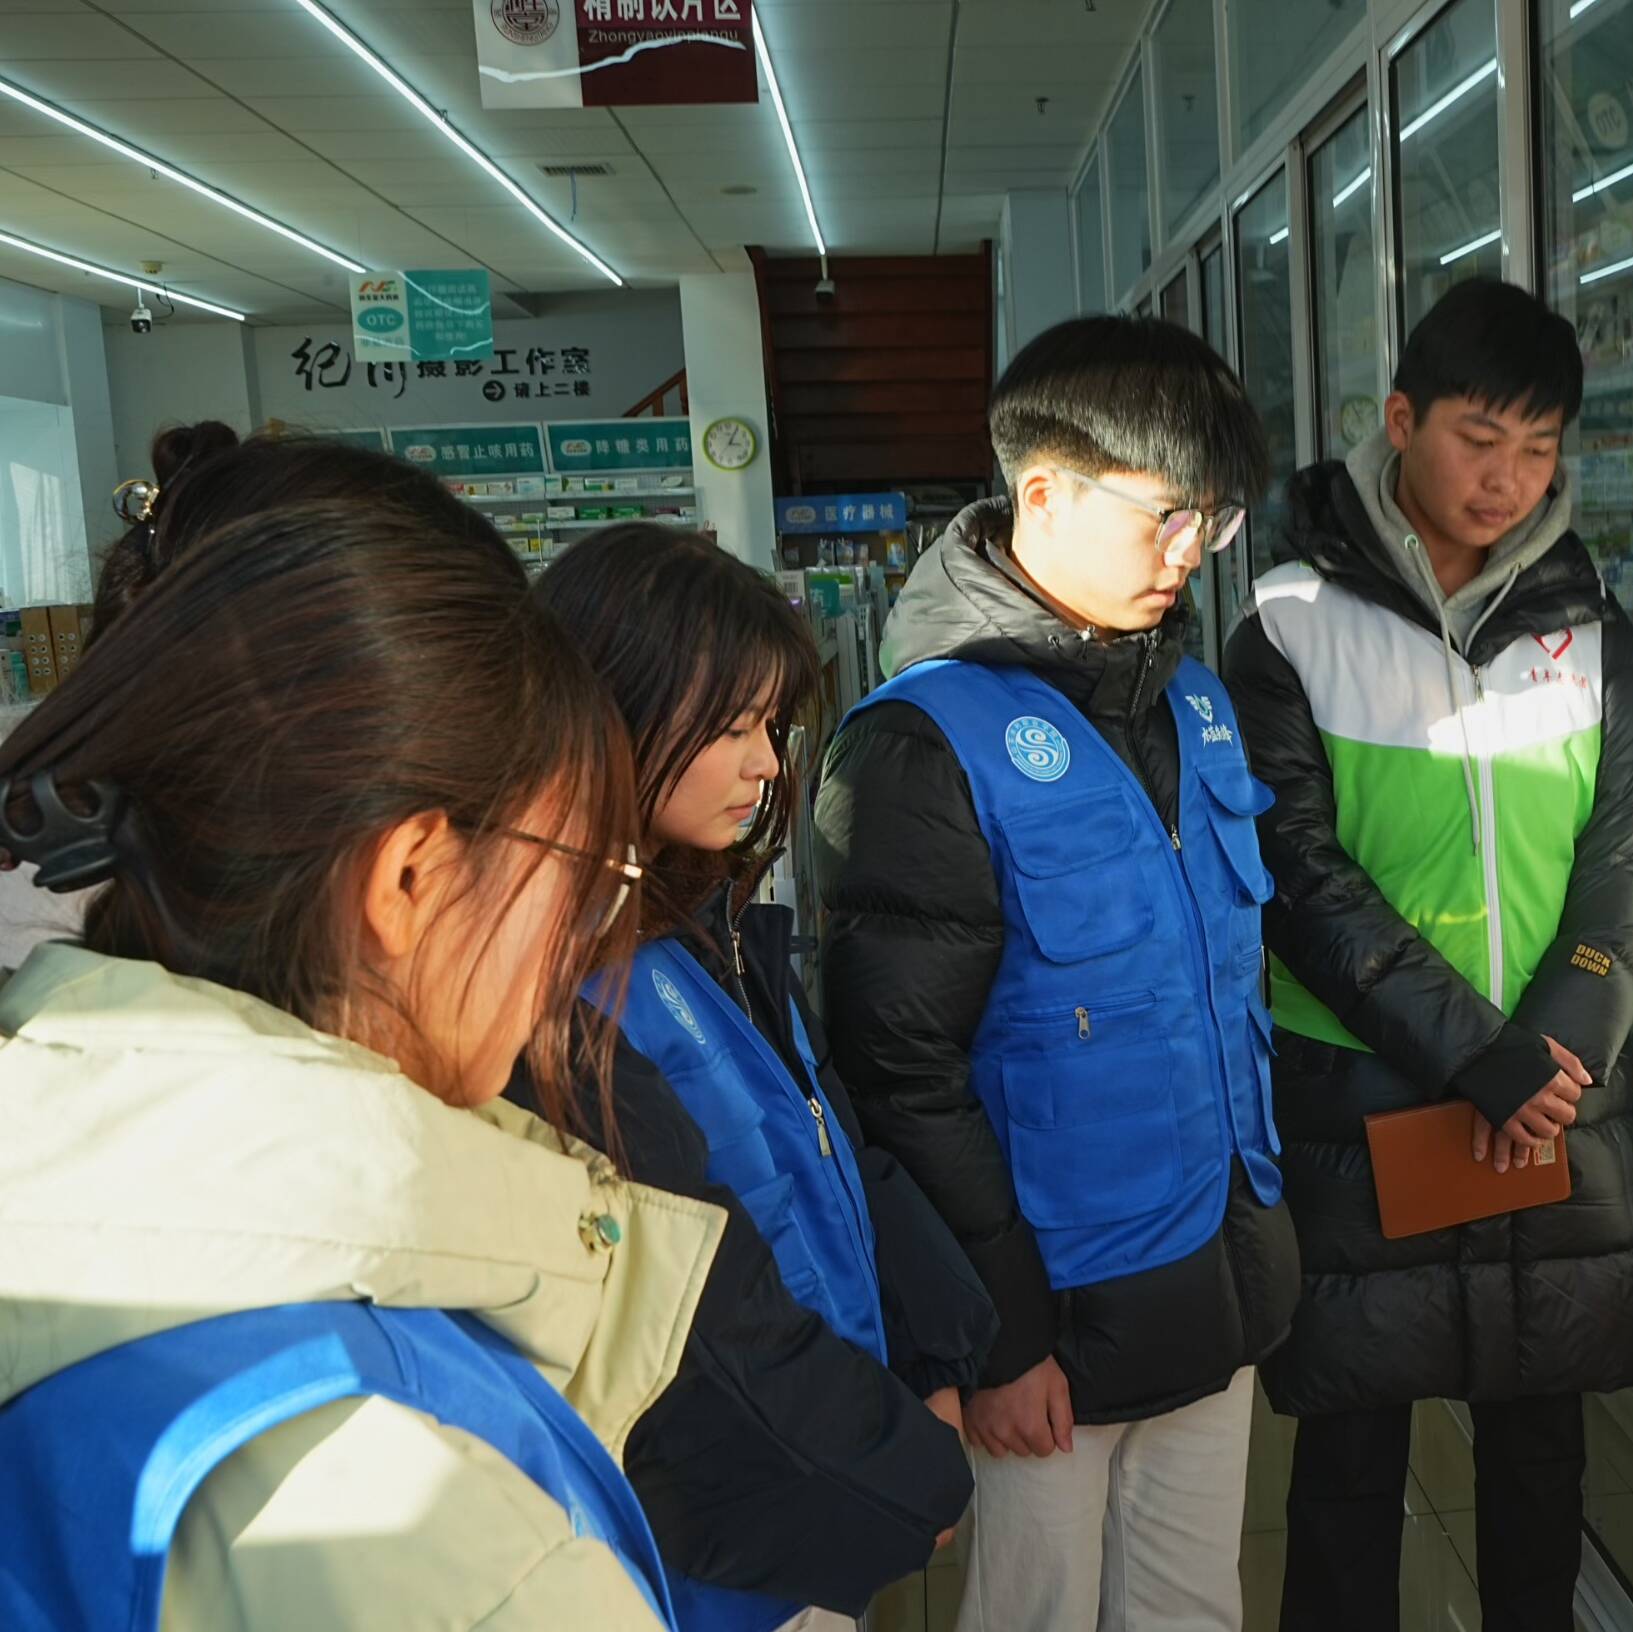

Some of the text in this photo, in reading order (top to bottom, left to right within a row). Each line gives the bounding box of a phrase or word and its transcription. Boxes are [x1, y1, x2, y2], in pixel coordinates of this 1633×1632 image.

[366, 315, 397, 326] OTC
[514, 380, 591, 399] 请上二楼
[595, 436, 691, 457] 降糖类用药
[823, 503, 895, 524] 医疗器械
[1570, 953, 1608, 977] DOWN
[1576, 944, 1611, 968] DUCK
